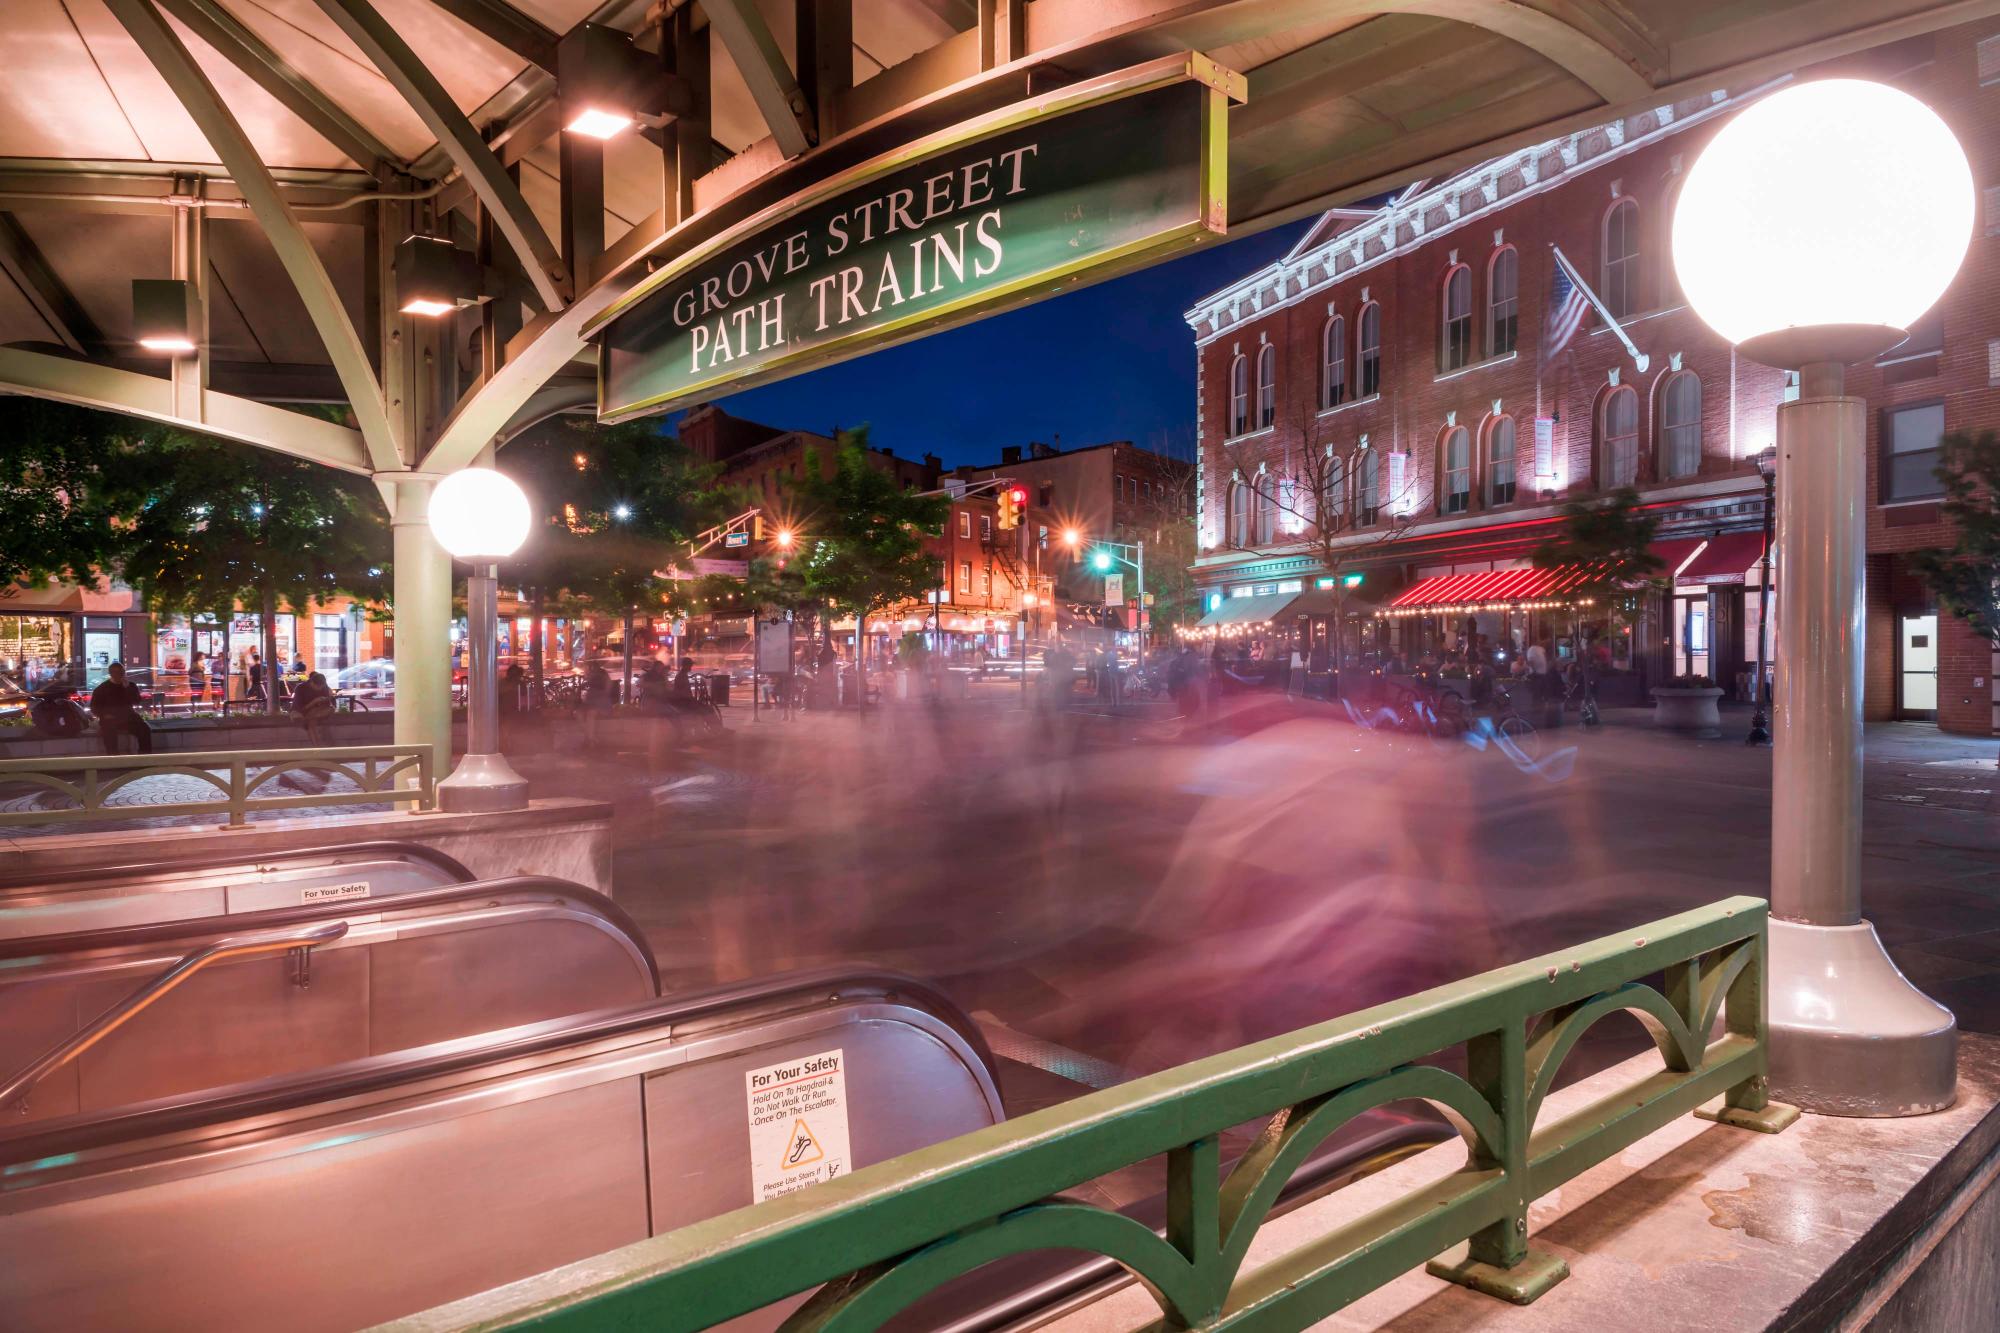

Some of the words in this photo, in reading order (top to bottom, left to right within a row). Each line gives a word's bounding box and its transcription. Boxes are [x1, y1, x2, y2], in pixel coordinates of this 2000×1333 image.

[673, 230, 810, 327] GROVE
[827, 143, 1038, 257] STREET
[689, 293, 786, 374] PATH
[809, 208, 1003, 332] TRAINS
[320, 888, 339, 896] Your
[341, 884, 366, 894] Safety
[752, 1075, 771, 1087] For
[774, 1067, 801, 1081] Your
[804, 1057, 839, 1074] Safety
[753, 1094, 771, 1104] Hold
[773, 1090, 784, 1100] On
[786, 1087, 794, 1096] To
[796, 1078, 827, 1093] Handrail
[828, 1077, 834, 1085] &
[753, 1106, 765, 1116] Do
[767, 1102, 780, 1112] Not
[782, 1095, 800, 1108] Walk
[802, 1093, 811, 1102] Or
[812, 1090, 827, 1099] Run
[754, 1114, 774, 1126] Once
[776, 1111, 787, 1120] On
[790, 1106, 802, 1116] The
[805, 1097, 837, 1112] Escalator.
[763, 1180, 784, 1192] Please
[785, 1176, 797, 1185] Use
[798, 1170, 815, 1180] Stairs
